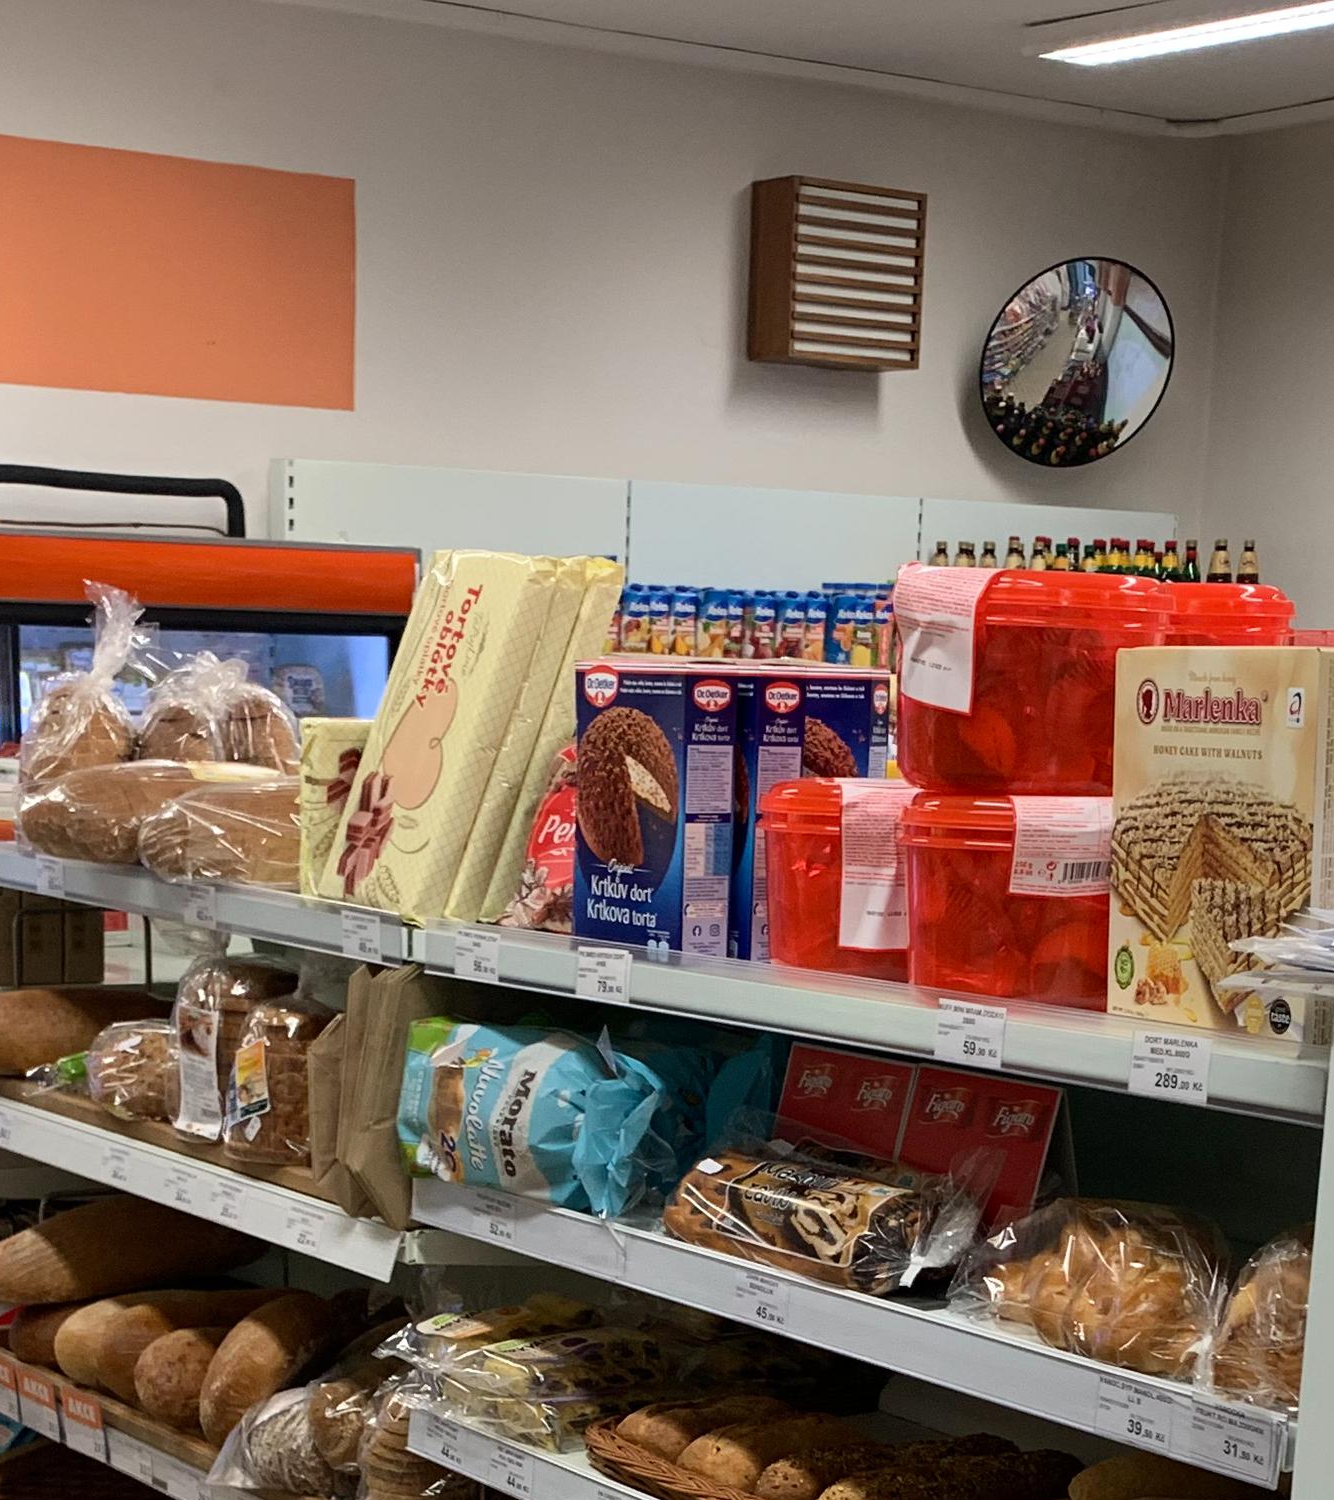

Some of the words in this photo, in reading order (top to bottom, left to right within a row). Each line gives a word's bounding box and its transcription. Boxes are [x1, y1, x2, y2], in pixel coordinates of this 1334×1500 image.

[435, 584, 483, 694] Tortové
[416, 610, 454, 708] oblátky
[1161, 686, 1262, 726] Marlenka
[1153, 745, 1178, 756] HONEY
[1180, 746, 1199, 757] CAKE
[1201, 746, 1222, 758] WITH
[1223, 747, 1263, 760] WALNUTS
[539, 813, 575, 847] Per
[590, 874, 628, 900] Krtkův
[629, 881, 652, 904] dort
[586, 898, 630, 926] Krtkova
[631, 911, 656, 928] torta
[797, 1069, 833, 1096] Figaro
[856, 1080, 893, 1108] Figaro
[1192, 1081, 1203, 1092] Kč
[925, 1091, 965, 1120] Figaro
[993, 1105, 1035, 1132] Figaro
[499, 1069, 538, 1177] Morato
